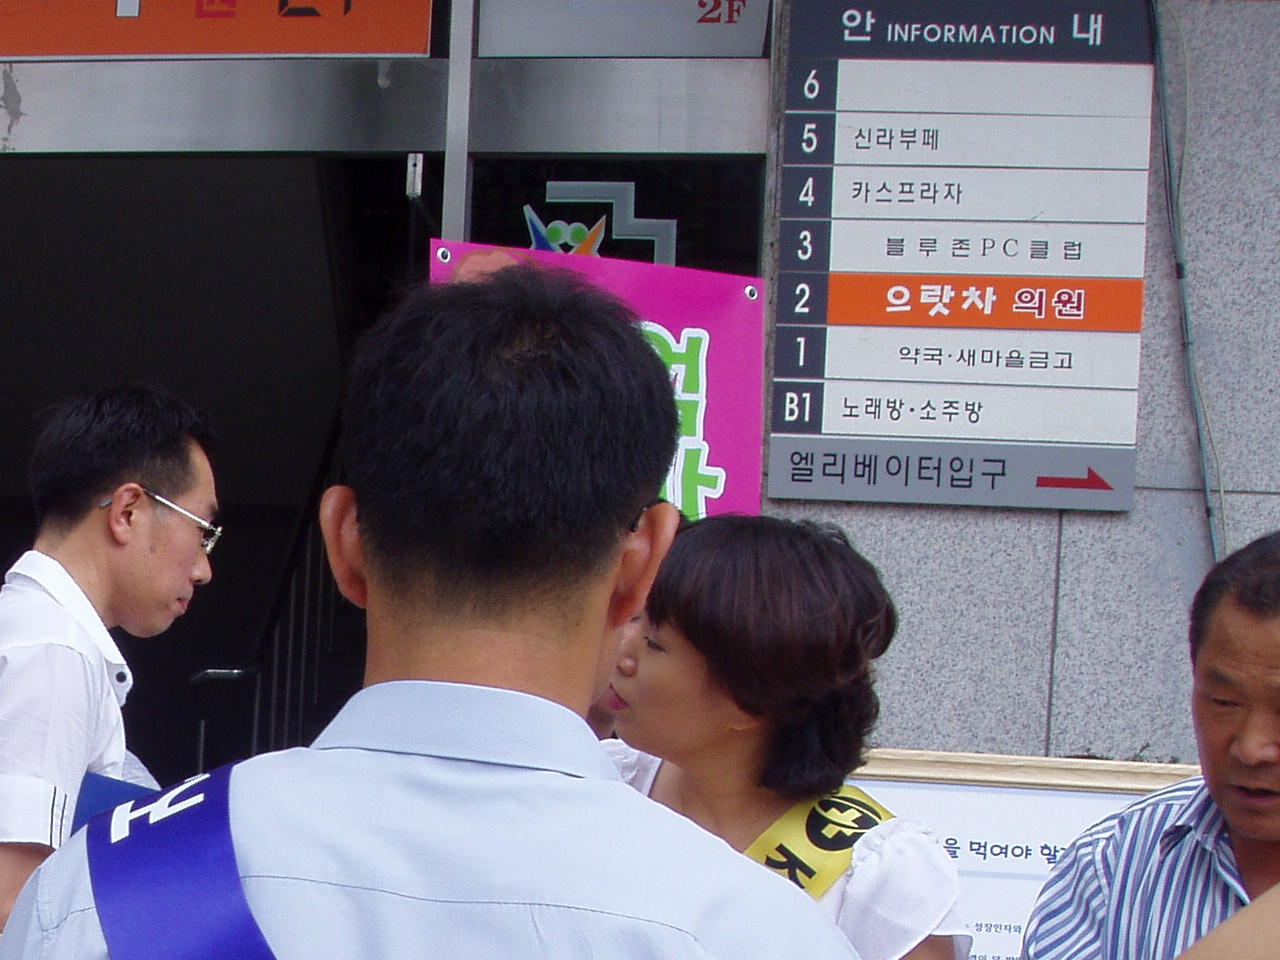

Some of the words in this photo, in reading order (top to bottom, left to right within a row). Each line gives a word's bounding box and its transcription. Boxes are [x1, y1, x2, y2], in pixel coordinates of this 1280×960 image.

[697, 0, 747, 25] 2F
[841, 9, 875, 43] 안
[886, 23, 1056, 45] INFORMATION
[1072, 13, 1103, 46] 내
[803, 70, 819, 99] 6
[802, 123, 818, 153] 5
[853, 127, 941, 152] 신라부페
[799, 178, 815, 207] 4
[851, 180, 963, 205] 카스프라자
[797, 231, 813, 260] 3
[795, 284, 810, 314] 2
[885, 284, 997, 317] 으랏차
[1012, 287, 1086, 320] 의원
[796, 337, 806, 366] 1
[784, 392, 811, 422] B1
[789, 450, 1008, 491] 엘리베이터입구
[969, 840, 1033, 861] 먹여야
